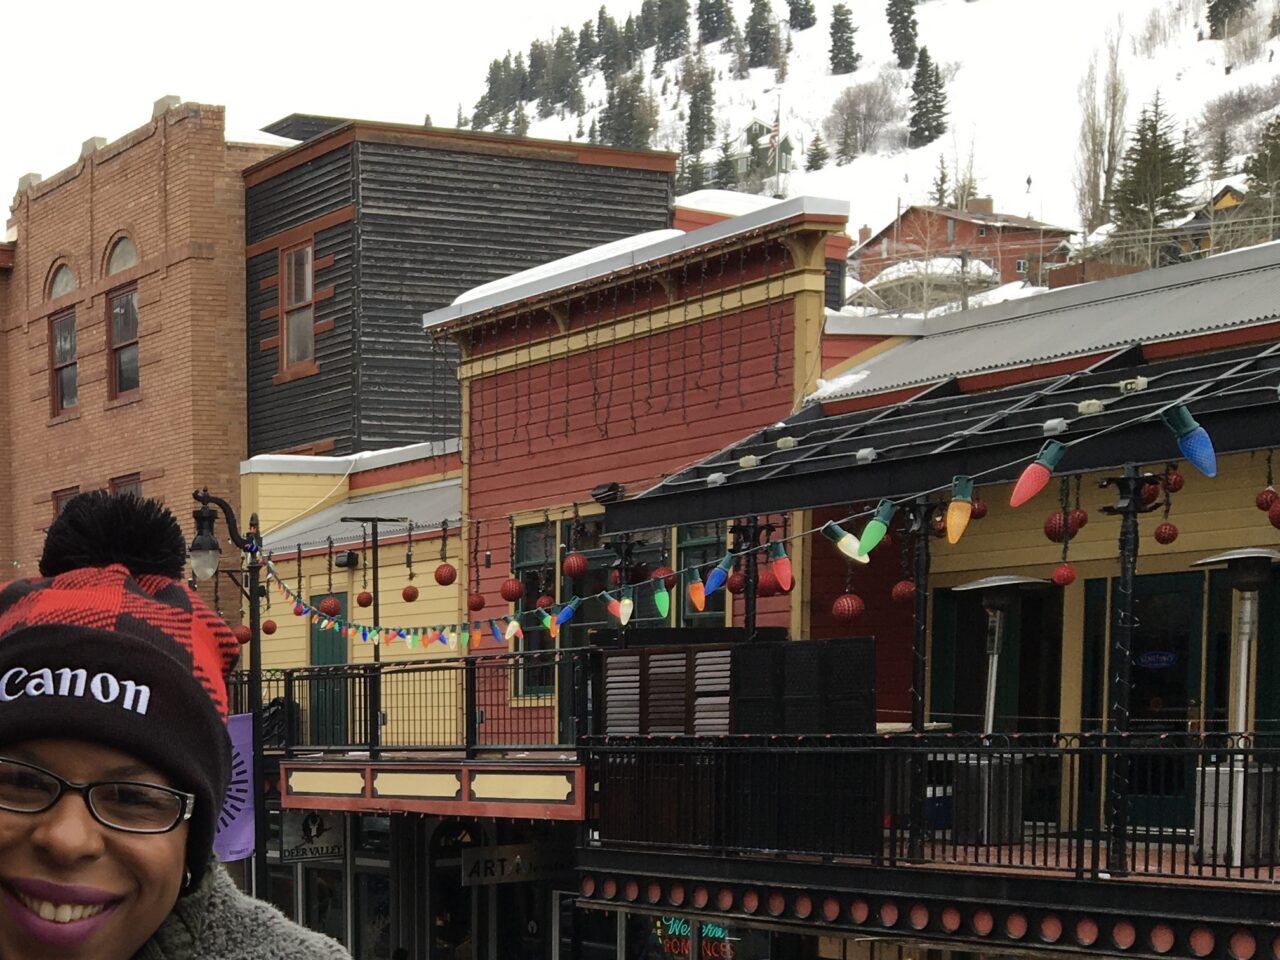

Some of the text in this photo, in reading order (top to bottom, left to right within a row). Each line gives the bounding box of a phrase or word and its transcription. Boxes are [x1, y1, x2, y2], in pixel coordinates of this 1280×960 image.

[283, 845, 342, 857] DEER VALLEY
[468, 858, 507, 877] ART
